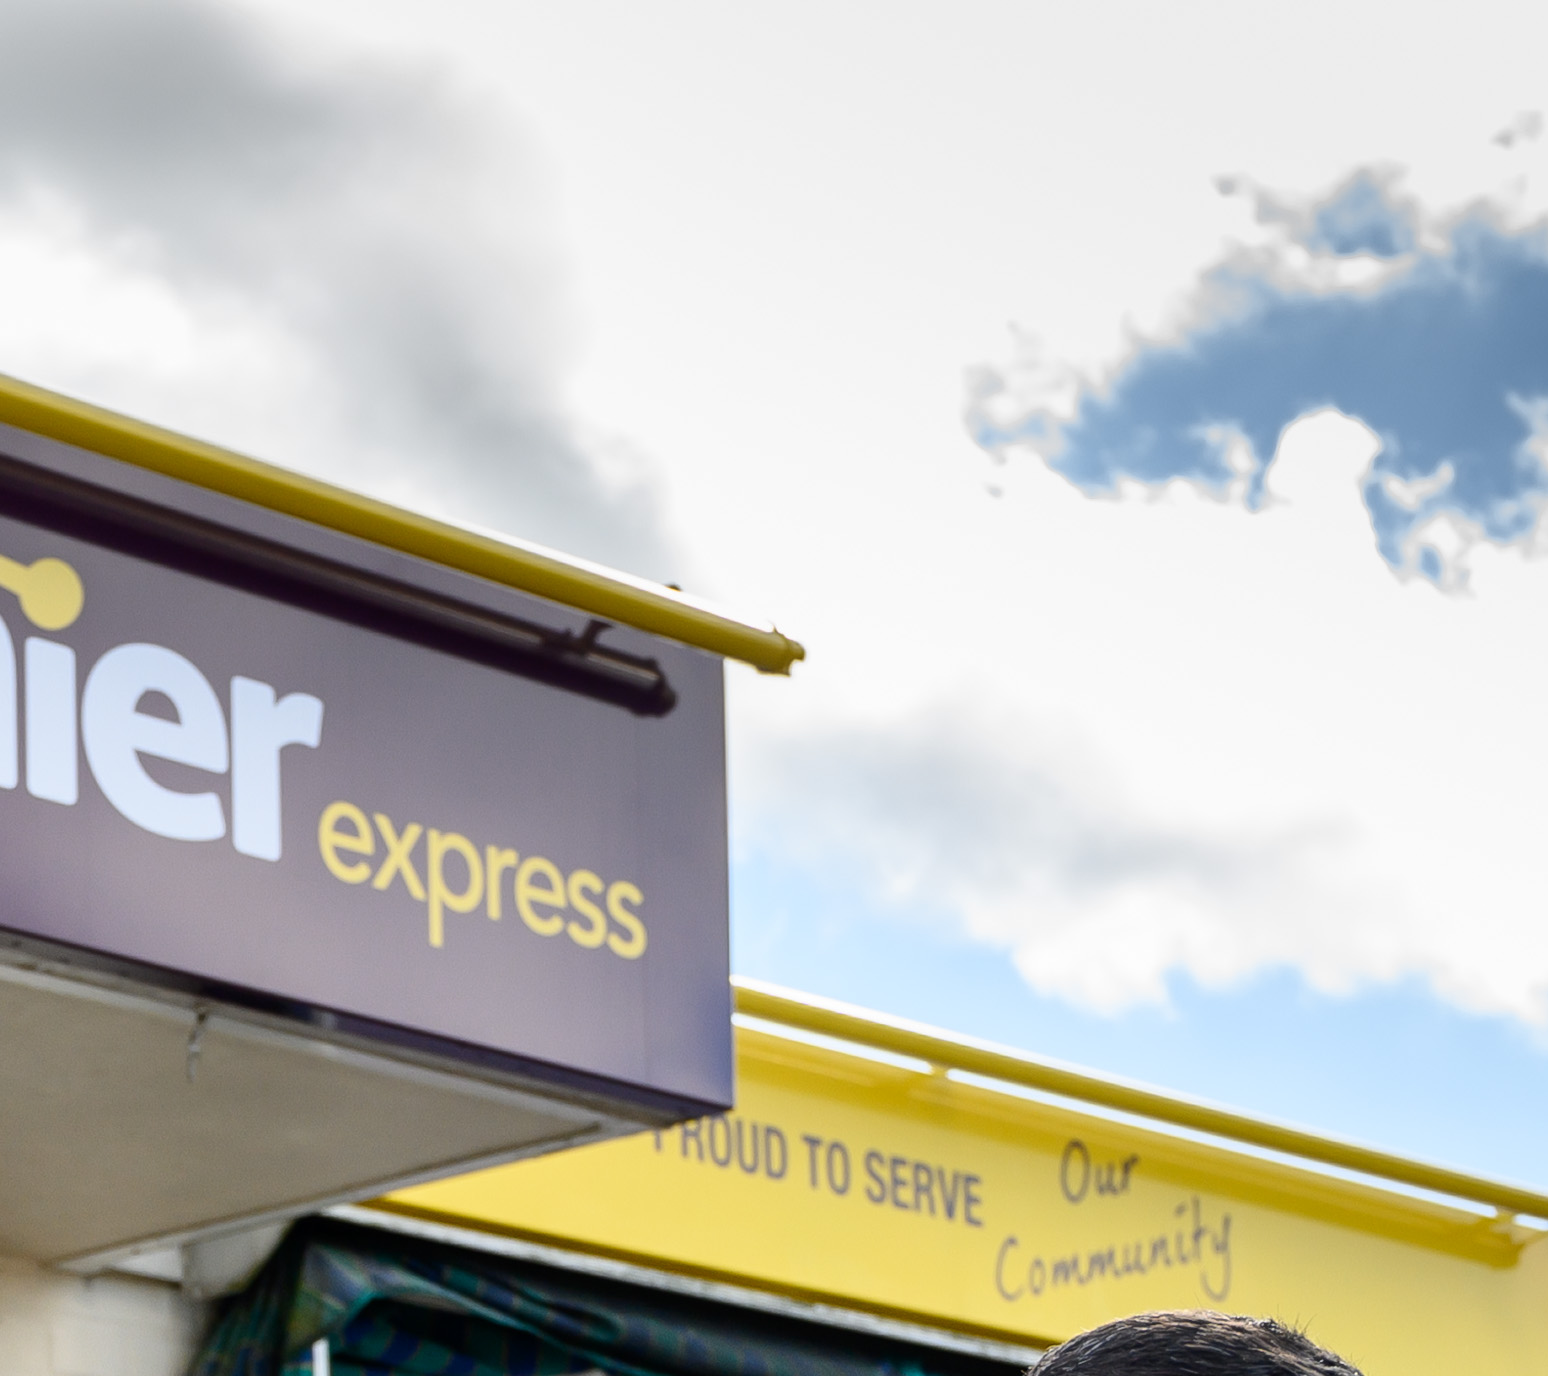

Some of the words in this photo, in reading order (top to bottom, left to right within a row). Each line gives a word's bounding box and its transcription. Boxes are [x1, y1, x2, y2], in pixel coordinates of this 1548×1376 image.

[317, 801, 648, 959] express
[802, 1135, 851, 1196] TO
[864, 1150, 983, 1227] SERVE
[1060, 1138, 1139, 1204] Our
[995, 1195, 1232, 1302] Community
